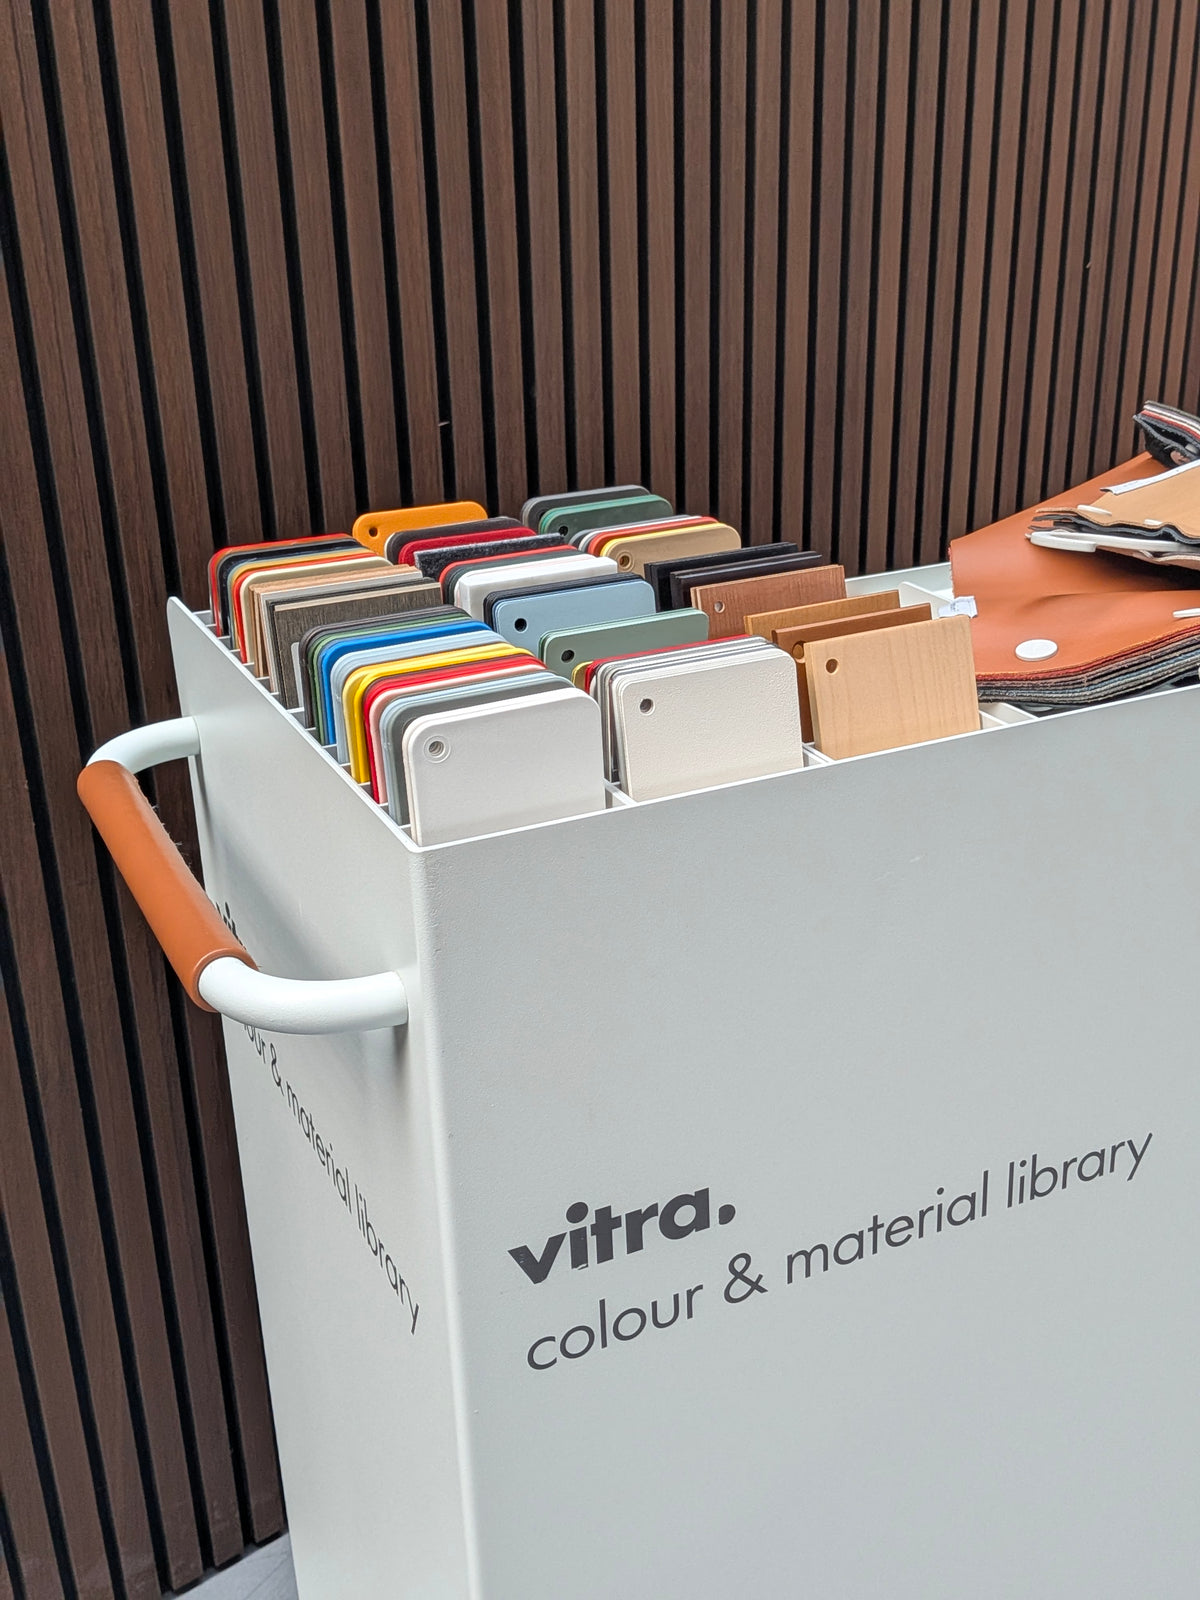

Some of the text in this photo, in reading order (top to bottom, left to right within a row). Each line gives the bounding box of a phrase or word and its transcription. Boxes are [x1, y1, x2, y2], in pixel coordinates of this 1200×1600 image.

[269, 1042, 285, 1097] &
[285, 1080, 352, 1214] material
[354, 1183, 420, 1335] library
[507, 1187, 736, 1286] vitra.
[526, 1132, 1153, 1371] colour & material library
